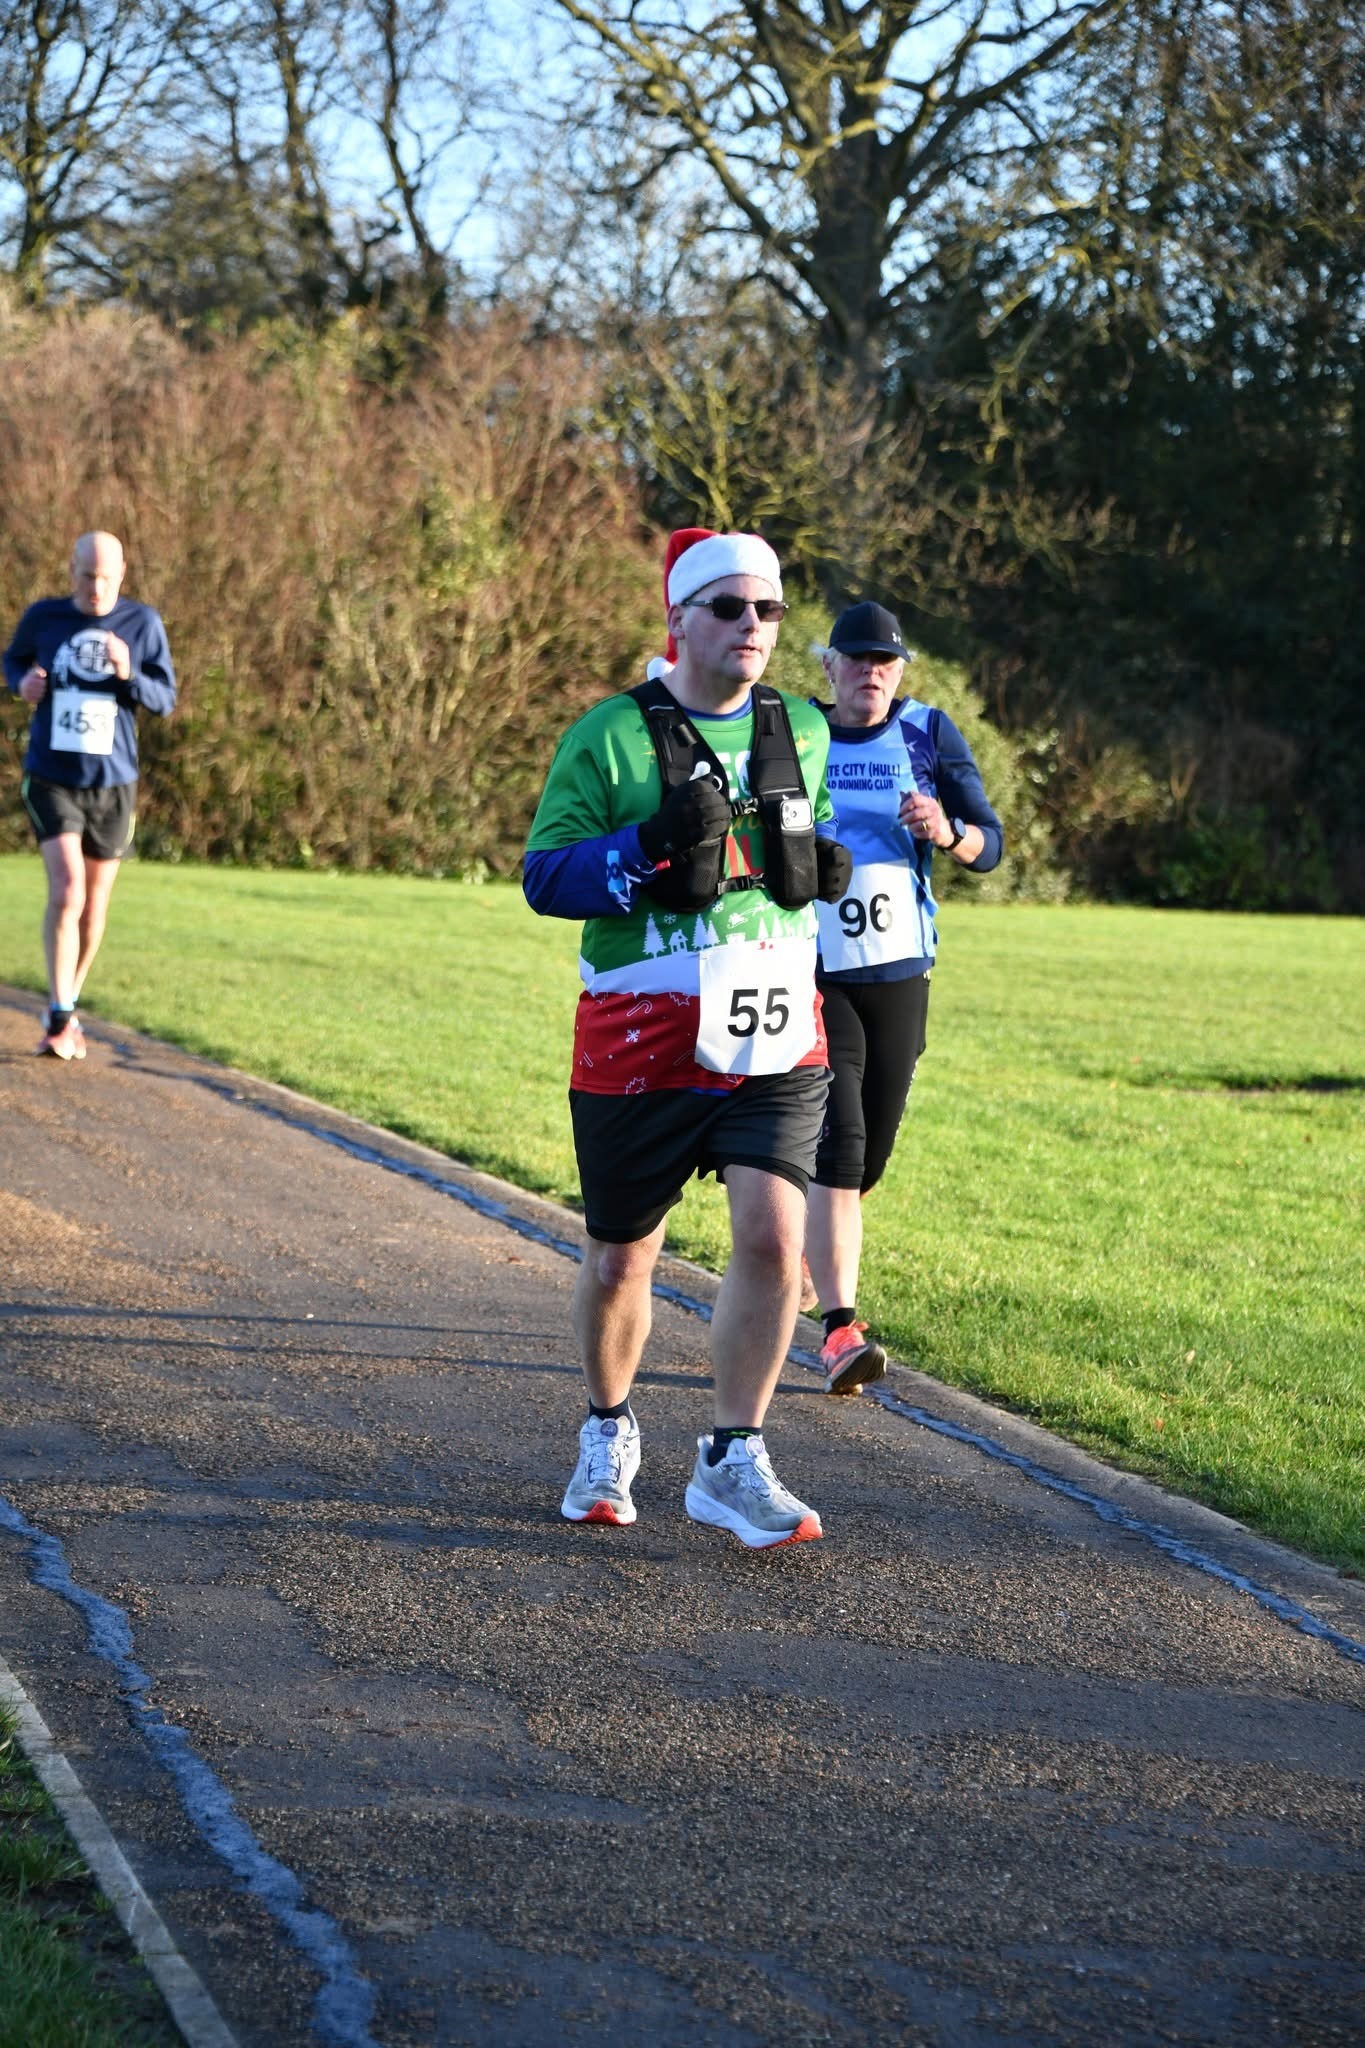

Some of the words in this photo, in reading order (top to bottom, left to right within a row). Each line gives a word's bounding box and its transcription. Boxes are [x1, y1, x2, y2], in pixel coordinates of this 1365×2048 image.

[842, 763, 866, 777] CITY
[868, 761, 900, 777] (HULL)
[838, 779, 873, 790] RUNNING
[874, 779, 894, 790] CLUB
[839, 893, 893, 938] 96
[727, 987, 790, 1038] 55
